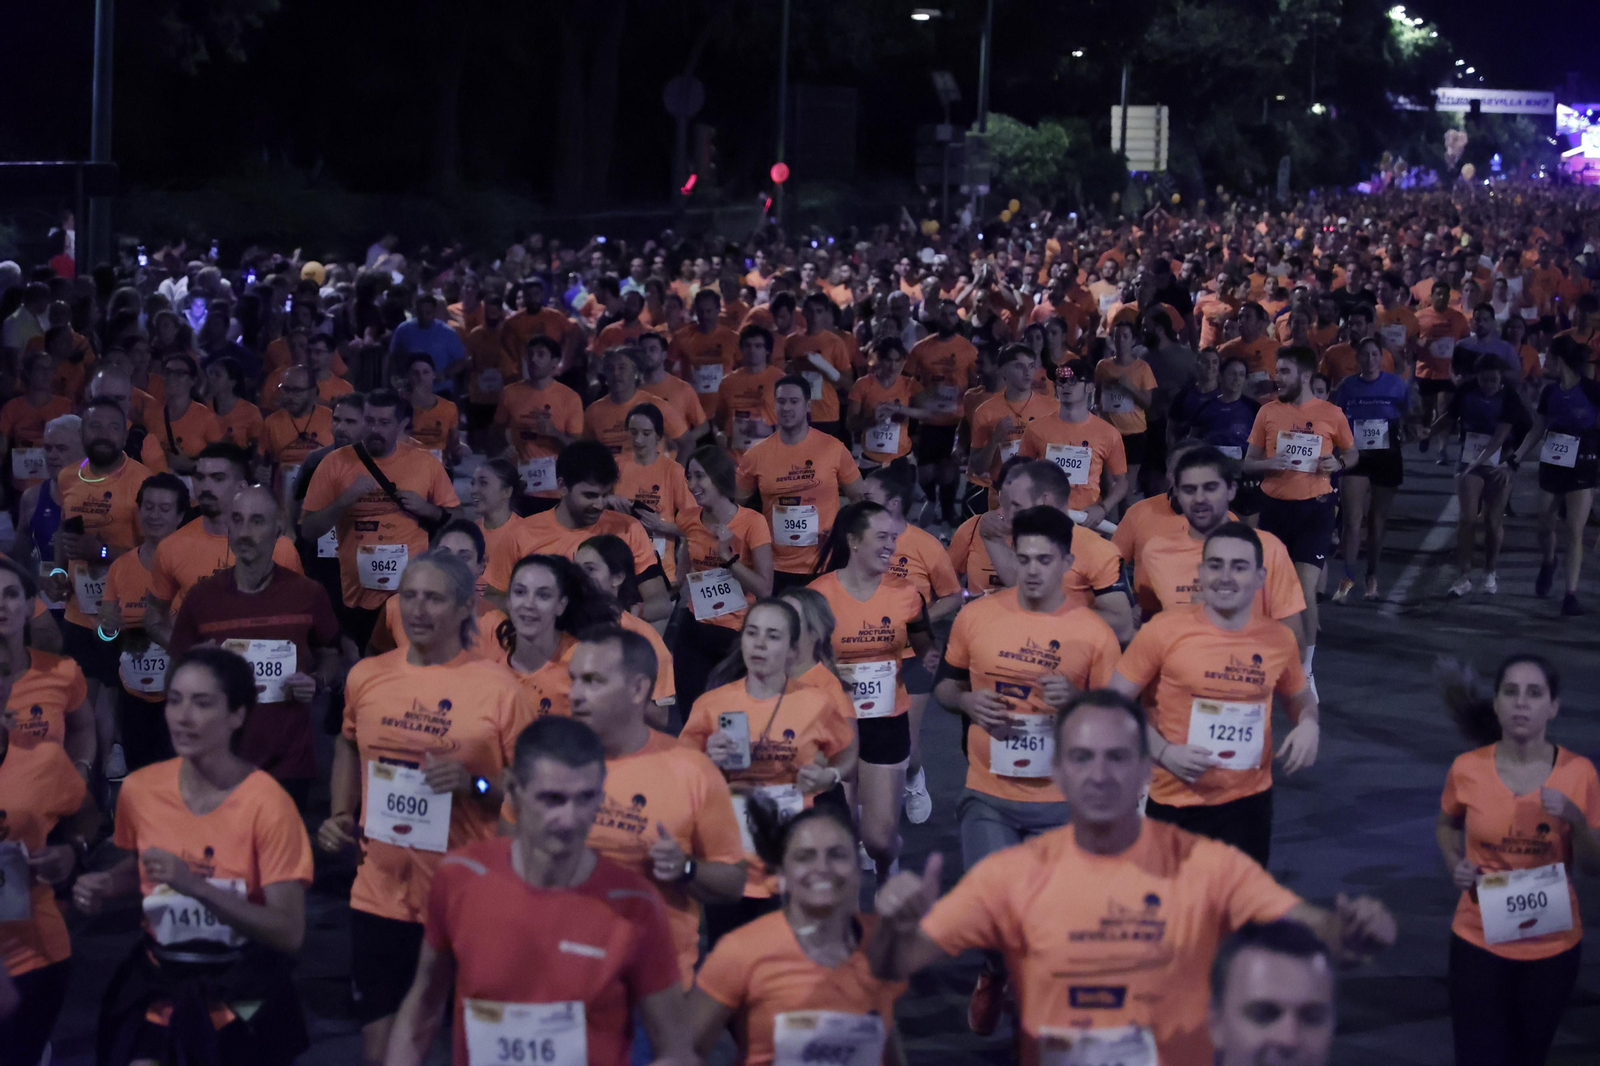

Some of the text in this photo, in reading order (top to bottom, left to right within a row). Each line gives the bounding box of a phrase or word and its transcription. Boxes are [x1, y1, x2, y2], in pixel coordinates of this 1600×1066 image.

[873, 431, 893, 440] 12712
[1286, 444, 1312, 456] 20765
[1550, 443, 1568, 453] 7223
[1056, 458, 1082, 468] 20502
[528, 470, 546, 478] 6431
[784, 519, 807, 530] 3945
[372, 561, 397, 572] 9642
[700, 582, 732, 599] 15168
[842, 636, 876, 644] SEVILLA
[999, 650, 1036, 664] SEVILLA
[1020, 648, 1062, 662] NOCTURNA
[131, 658, 166, 671] 11373
[1225, 666, 1266, 676] NOCTURNA
[1205, 671, 1243, 682] SEVILLA
[852, 681, 882, 695] 7951
[382, 716, 422, 731] SEVILLA
[404, 712, 452, 726] NOCTURNA
[1209, 724, 1253, 742] 12215
[1004, 736, 1044, 750] 12461
[387, 793, 428, 816] 6690
[1506, 891, 1548, 912] 5960
[170, 908, 217, 926] 1418
[498, 1038, 555, 1062] 3616
